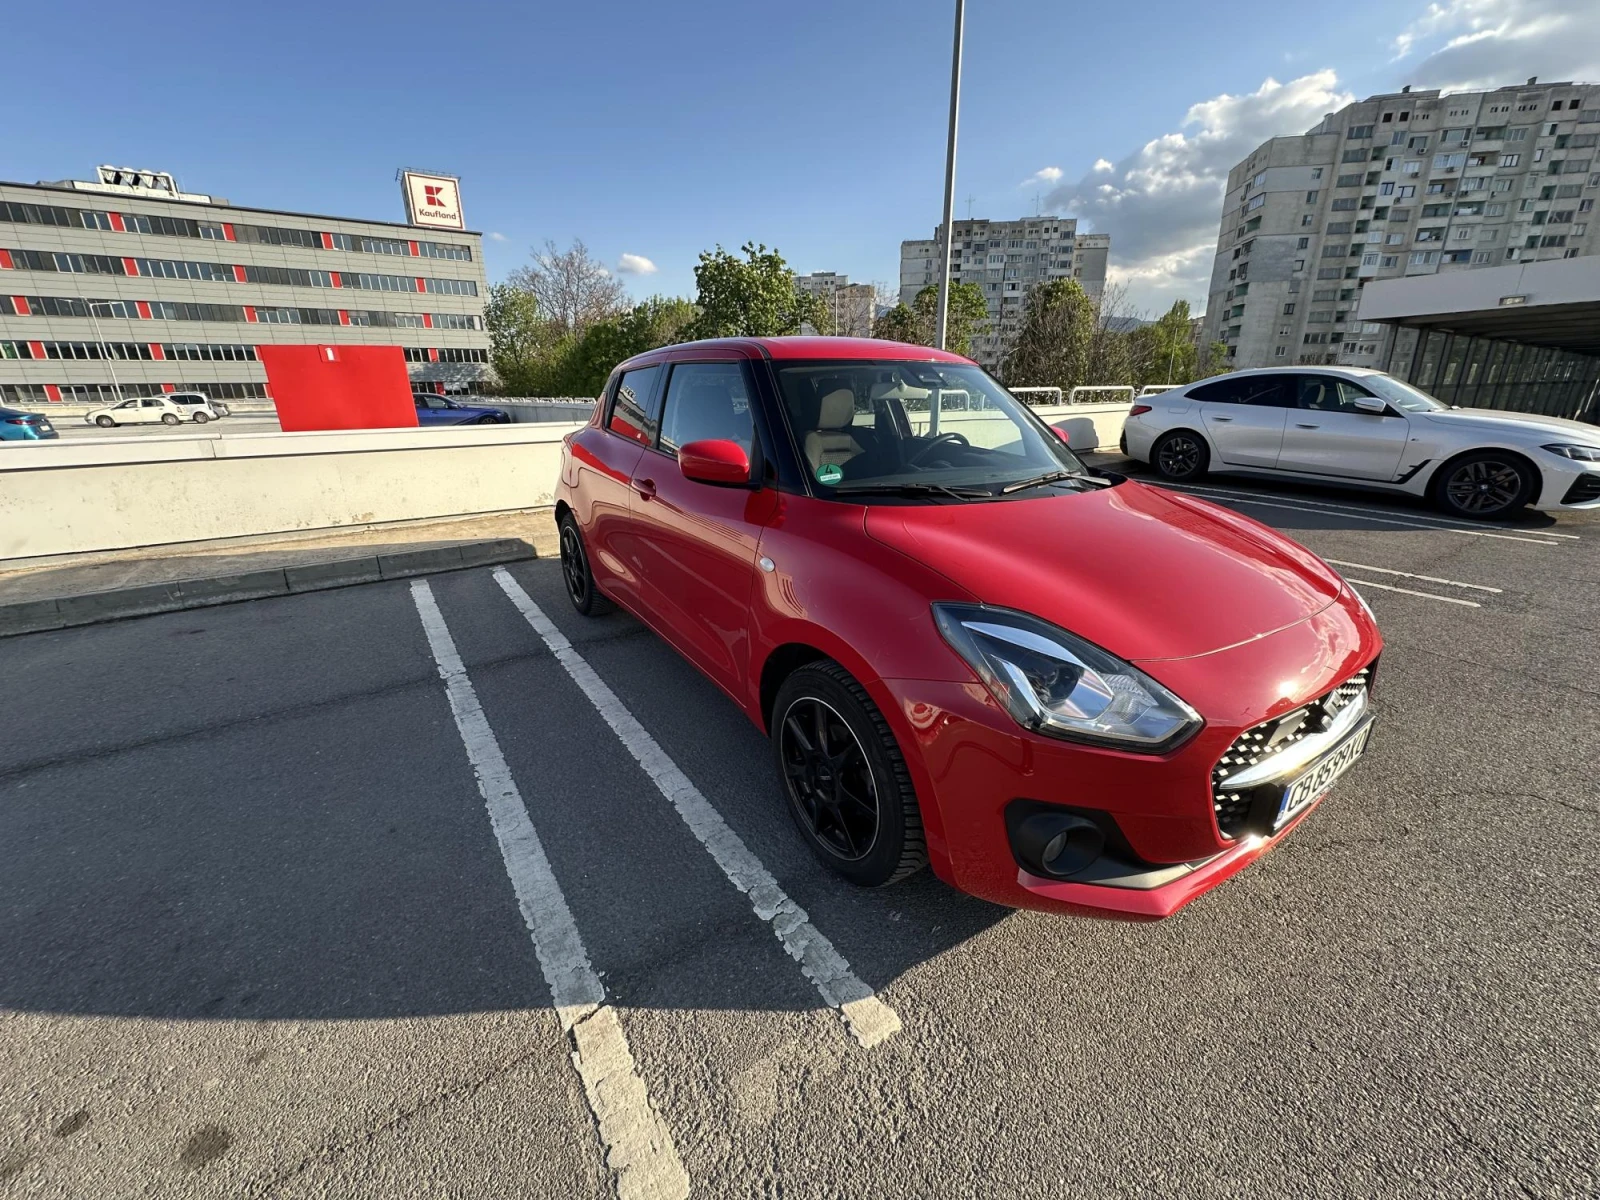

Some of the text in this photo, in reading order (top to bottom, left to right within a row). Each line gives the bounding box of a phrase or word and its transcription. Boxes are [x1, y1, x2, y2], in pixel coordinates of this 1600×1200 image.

[419, 208, 456, 220] Kaufland
[825, 464, 833, 474] 4
[1287, 772, 1314, 812] CB
[1312, 743, 1351, 794] 8599
